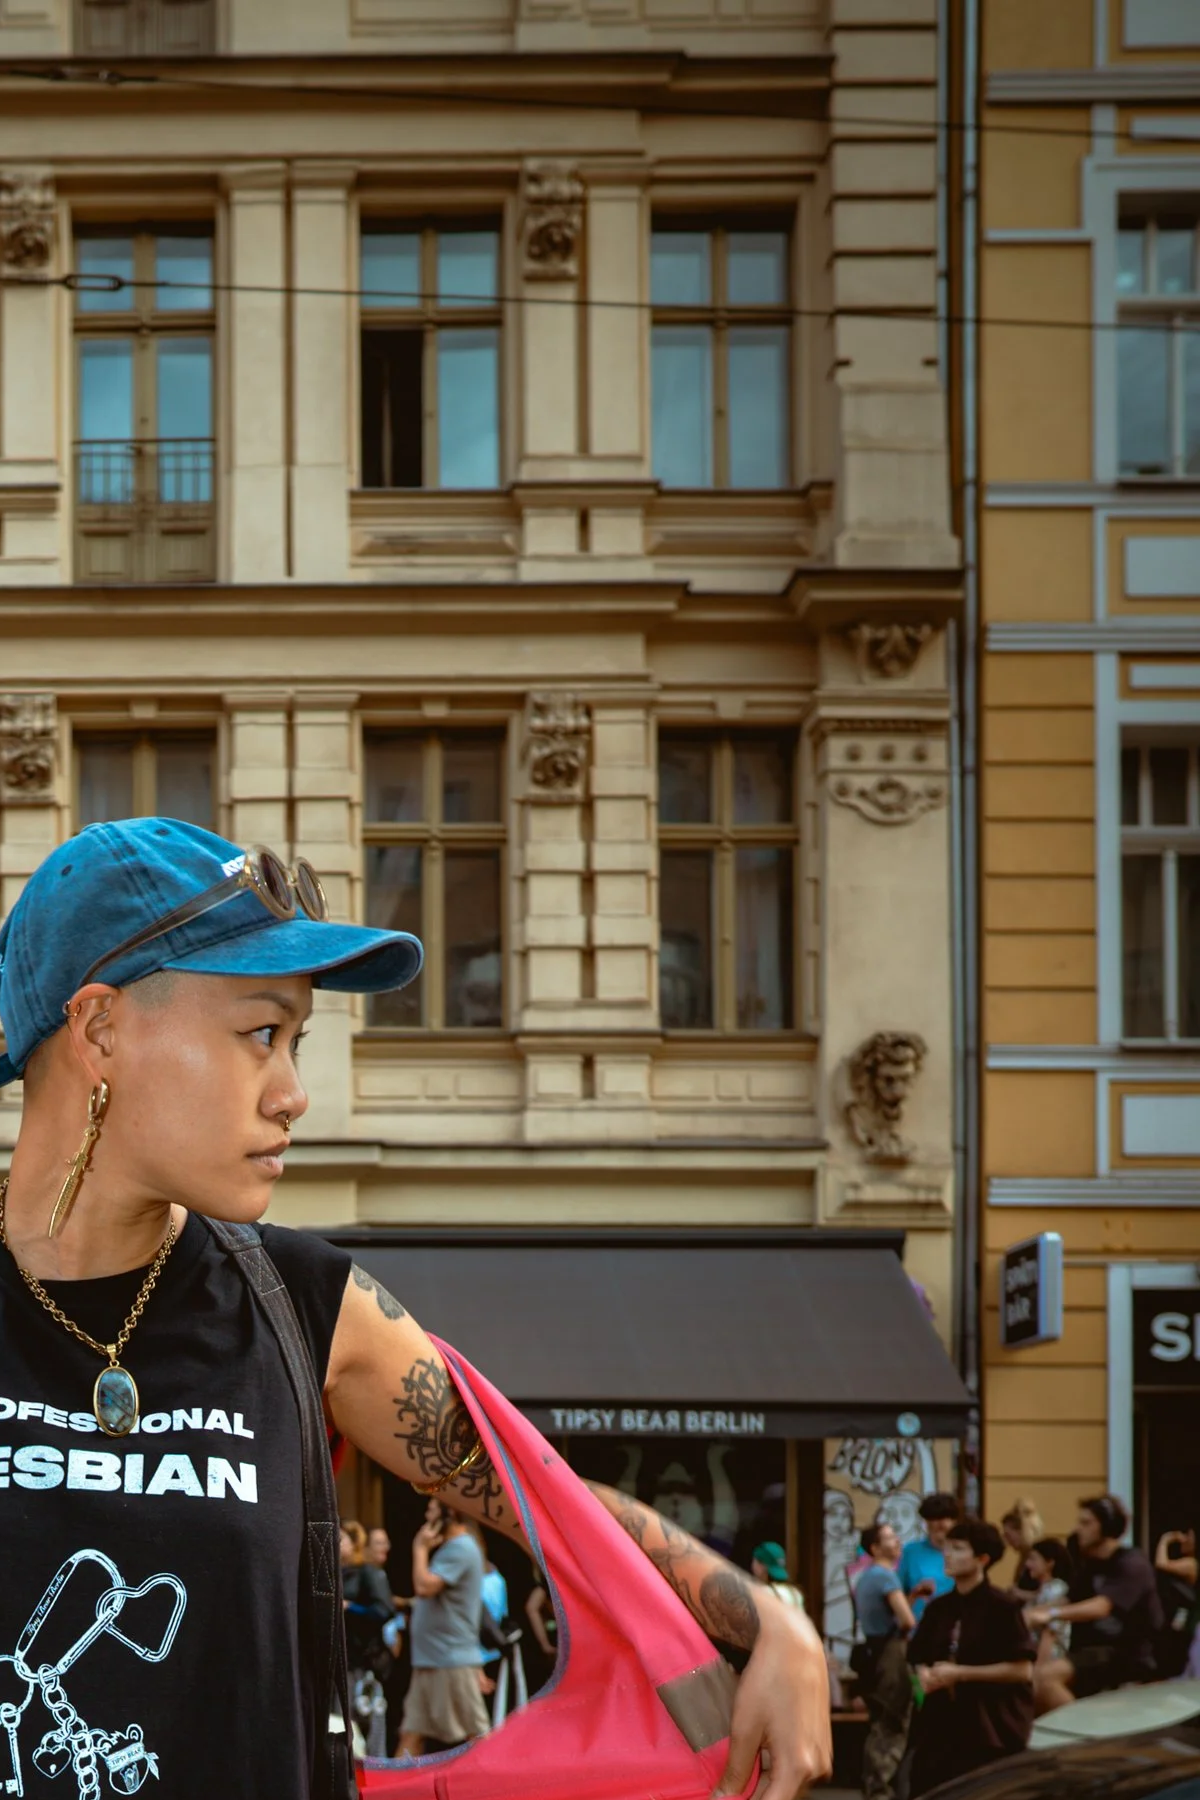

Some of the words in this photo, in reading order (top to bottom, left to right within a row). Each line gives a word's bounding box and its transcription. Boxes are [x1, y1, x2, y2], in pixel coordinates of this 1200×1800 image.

[1150, 1311, 1200, 1362] S
[551, 1409, 615, 1431] TIPSY
[685, 1410, 765, 1433] BERLIN
